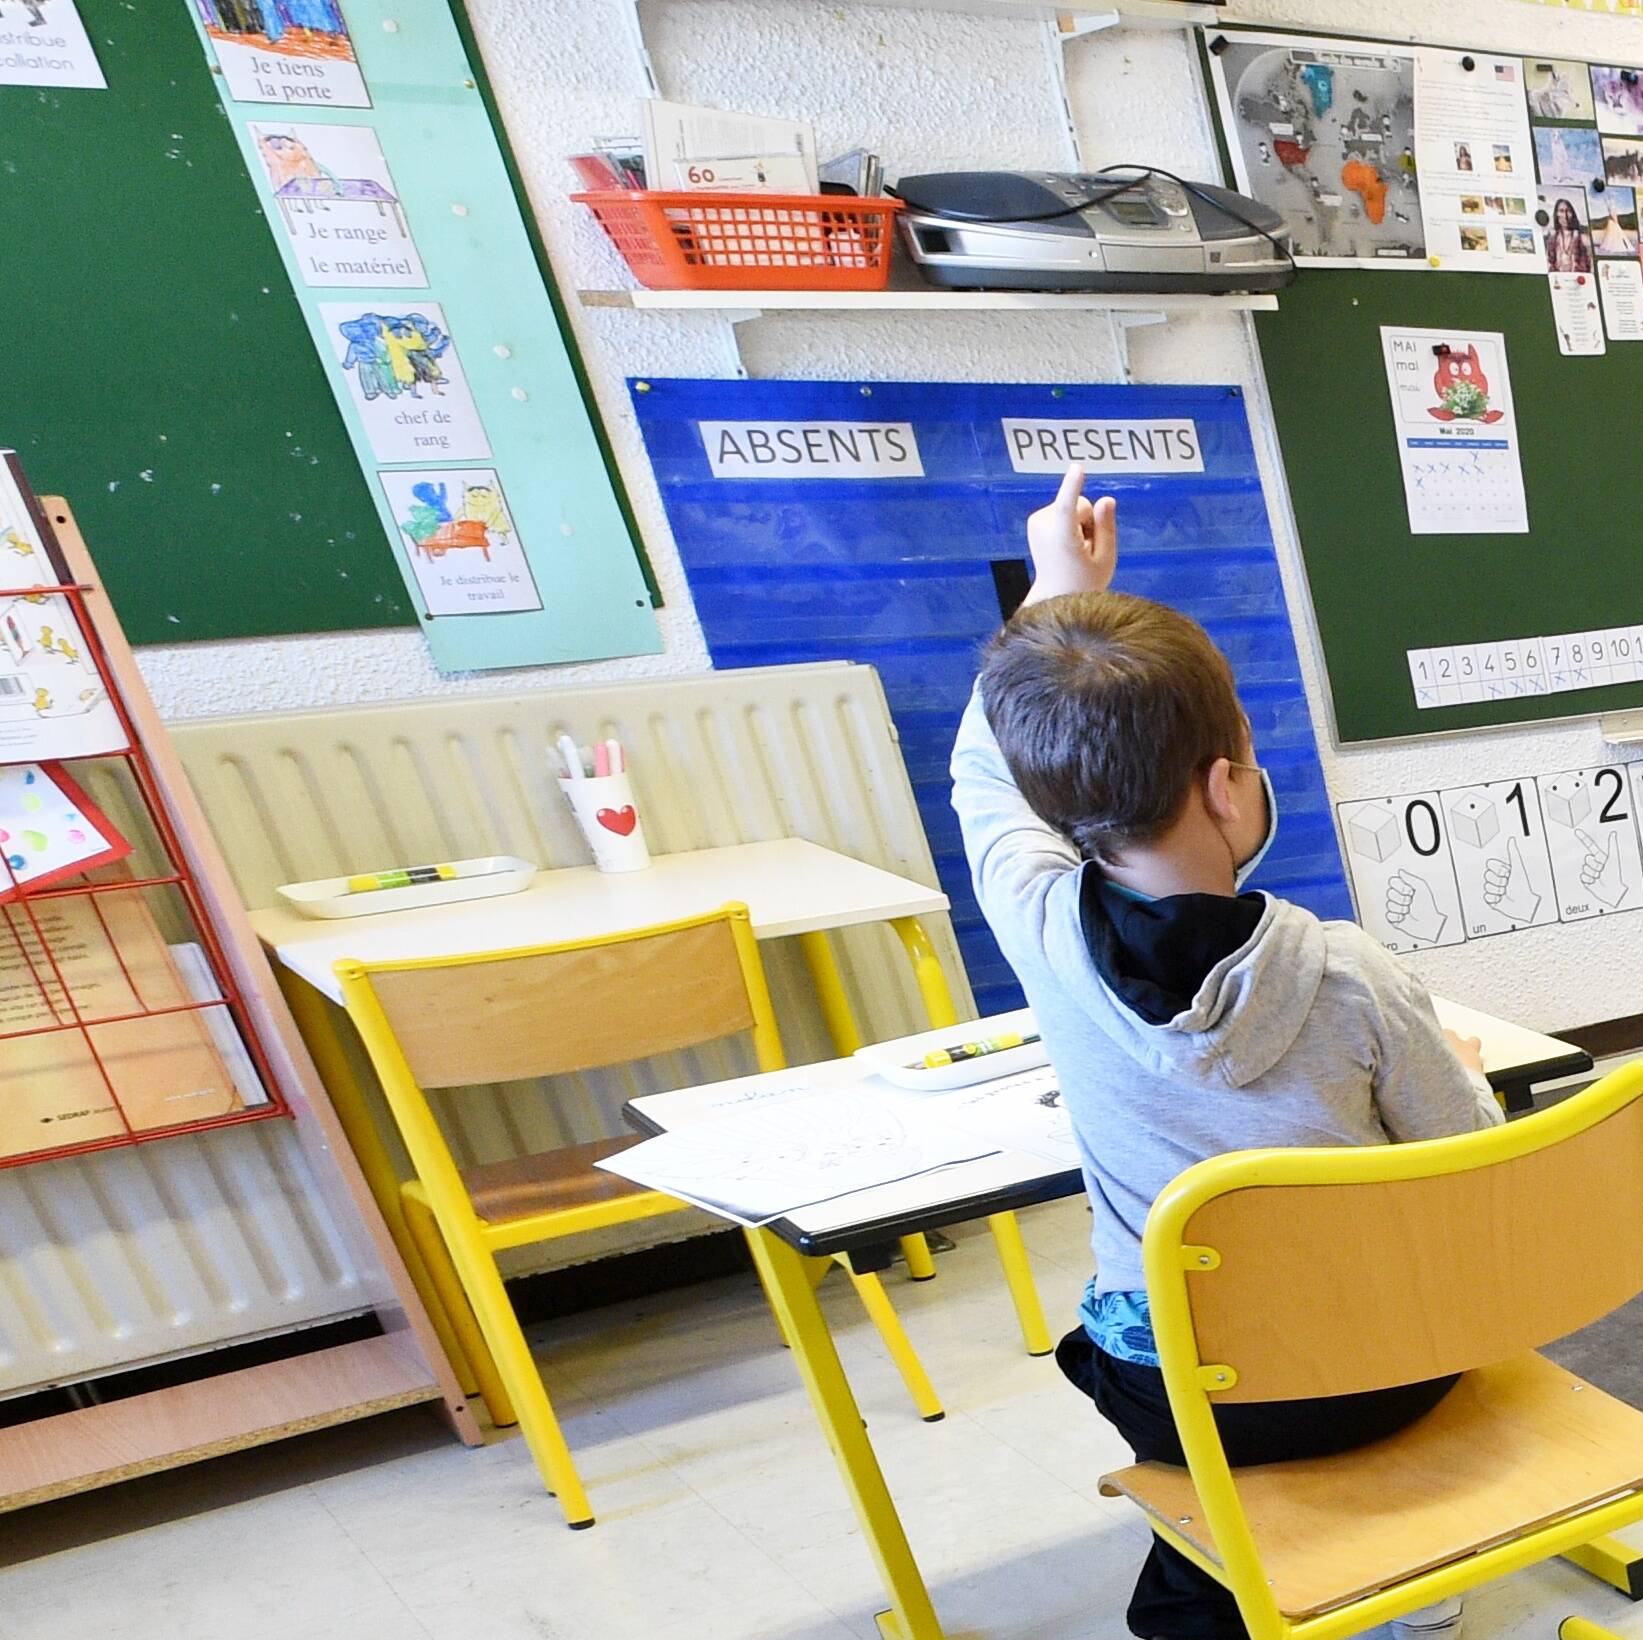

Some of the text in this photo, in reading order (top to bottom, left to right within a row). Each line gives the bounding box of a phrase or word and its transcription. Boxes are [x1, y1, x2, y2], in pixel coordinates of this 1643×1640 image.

[0, 32, 66, 47] stribue
[250, 57, 324, 77] Je tiens
[256, 79, 331, 101] la porte
[688, 166, 715, 184] 60
[309, 222, 387, 245] Je range
[310, 256, 412, 275] le matériel
[1393, 340, 1417, 353] MAI
[1396, 360, 1420, 372] mai
[395, 410, 451, 425] chef de
[414, 433, 450, 449] rang
[717, 427, 907, 465] ABSENTS
[1013, 426, 1196, 461] PRESENTS
[440, 572, 519, 587] Je distribue le
[1418, 661, 1429, 680] 1
[1438, 659, 1451, 678] 2
[1461, 657, 1473, 676] 3
[1484, 654, 1496, 673] 4
[1504, 652, 1517, 671] 5
[1526, 650, 1538, 669] 6
[1551, 647, 1561, 666] 7
[1572, 645, 1584, 664] 8
[1592, 642, 1604, 661] 9
[1610, 638, 1631, 658] 10
[1405, 799, 1441, 857] 0
[1505, 782, 1530, 837] 1
[1593, 768, 1629, 824] 2
[1565, 902, 1590, 916] deux
[1473, 924, 1487, 935] un
